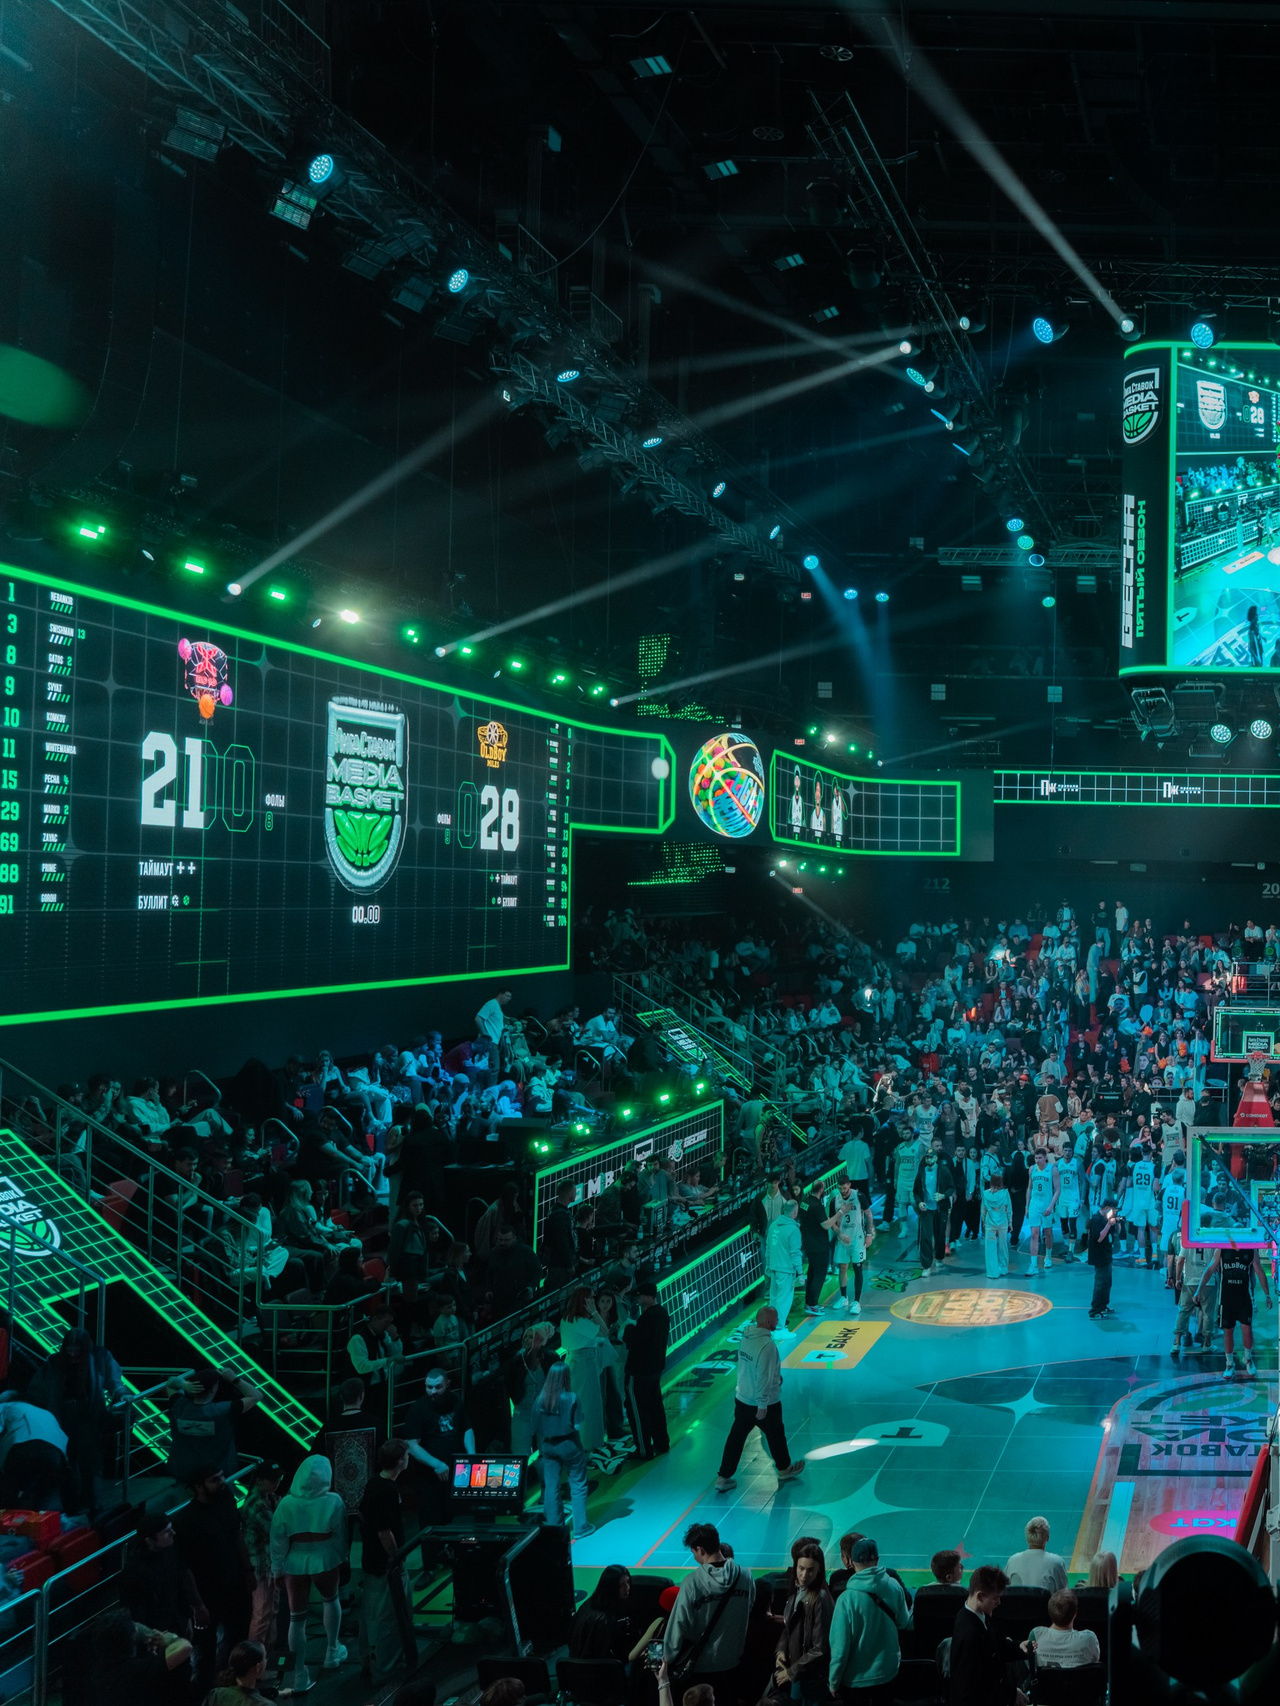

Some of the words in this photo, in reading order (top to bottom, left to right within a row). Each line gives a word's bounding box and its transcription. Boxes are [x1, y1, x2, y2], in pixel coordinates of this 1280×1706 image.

[1136, 500, 1146, 565] СЕЗОН
[9, 582, 15, 602] 1
[1135, 567, 1145, 638] ПЯТЫЙ
[7, 614, 18, 633] 3
[6, 645, 16, 665] 8
[5, 676, 15, 696] 9
[4, 707, 20, 728] 10
[3, 738, 16, 759] 11
[480, 742, 507, 762] OLDBOY
[2, 769, 18, 790] 15
[141, 731, 205, 828] 21
[326, 756, 404, 791] MEDIA
[265, 793, 285, 808] ФОЛЫ
[325, 783, 405, 812] BASKET
[0, 801, 20, 821] 29
[480, 785, 520, 852] 28
[0, 832, 19, 852] 69
[0, 863, 19, 883] 88
[139, 859, 174, 877] ТАЙМАУТ
[922, 877, 951, 890] 212
[138, 895, 168, 910] БУЛЛИТ
[352, 905, 381, 924] 00.00
[1063, 1176, 1070, 1185] 15
[1135, 1172, 1151, 1186] 29
[1166, 1196, 1179, 1210] 91
[1223, 1262, 1248, 1271] OLDBOY
[825, 1327, 860, 1349] БАНК
[1150, 1443, 1259, 1457] ТАВОК
